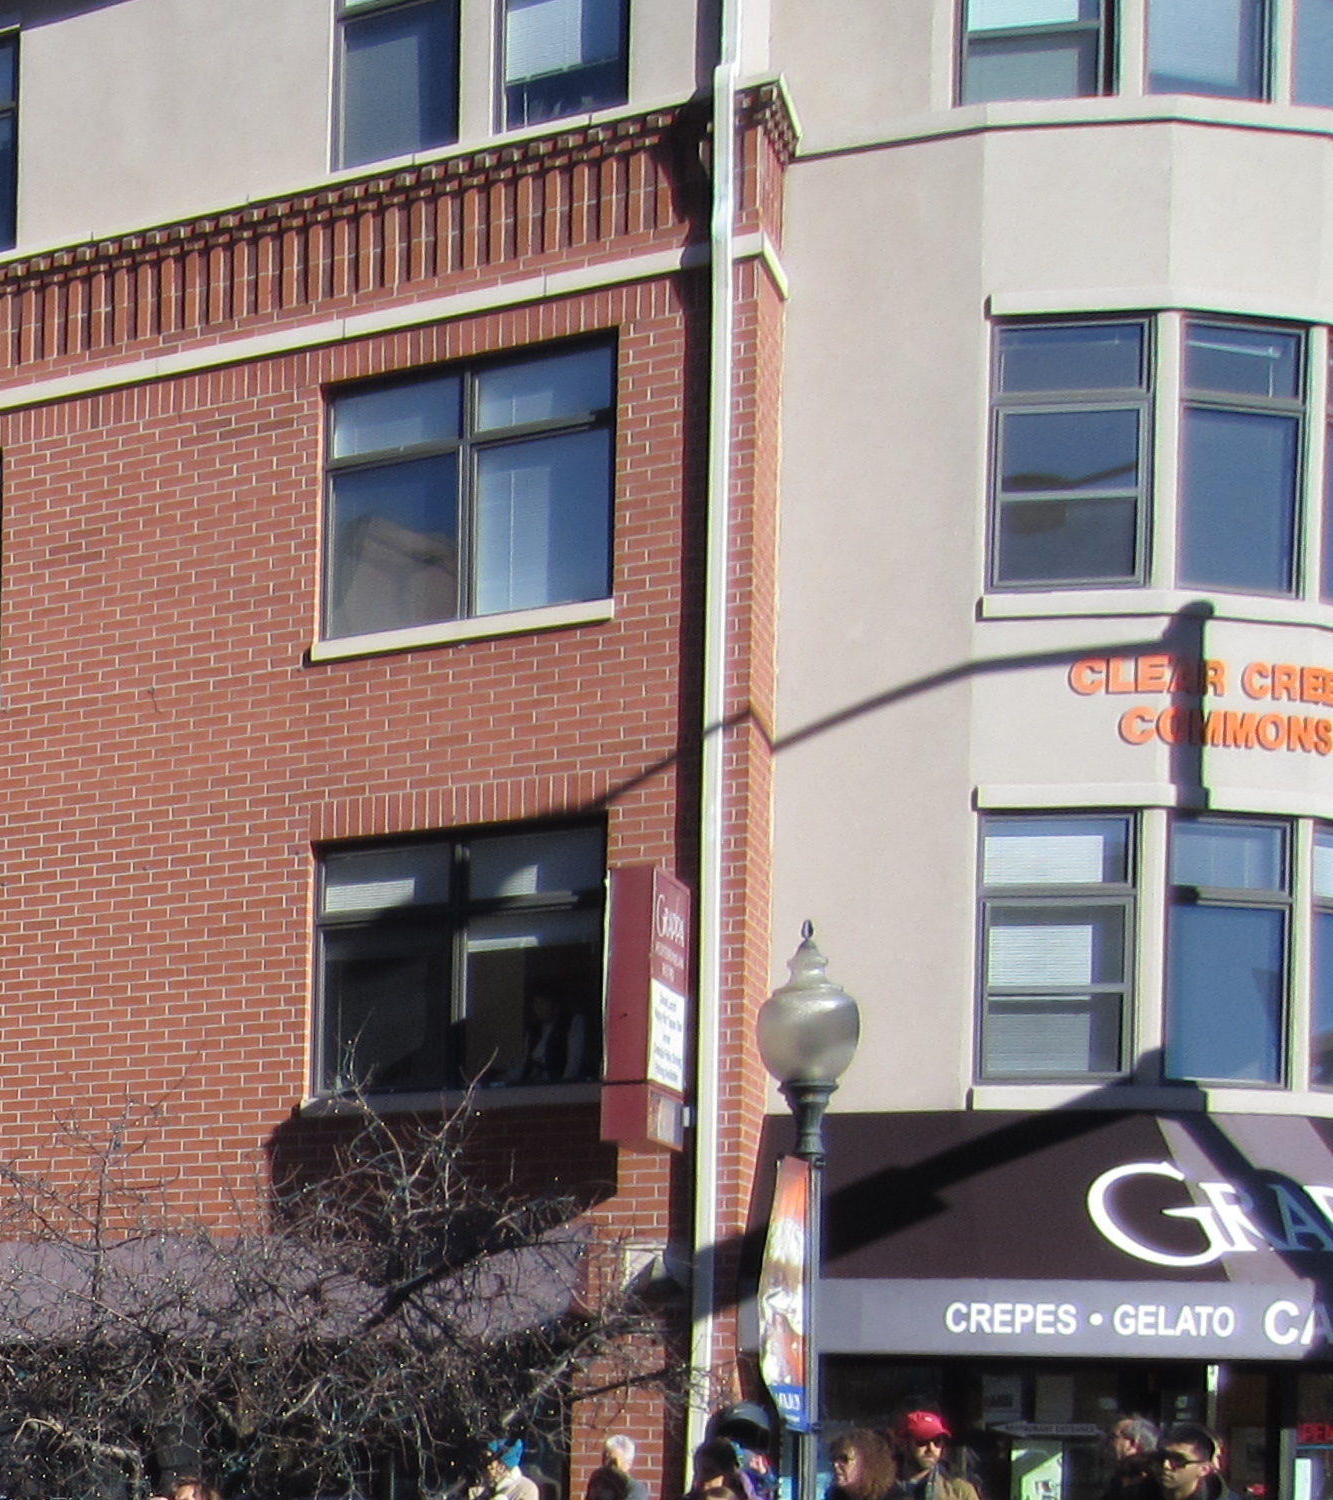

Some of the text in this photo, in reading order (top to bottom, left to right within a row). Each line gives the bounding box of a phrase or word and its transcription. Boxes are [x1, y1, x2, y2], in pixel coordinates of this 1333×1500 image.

[1068, 655, 1226, 697] CLEAR
[1117, 706, 1333, 756] COMMONS
[945, 1303, 1234, 1337] CREPES GELATO
